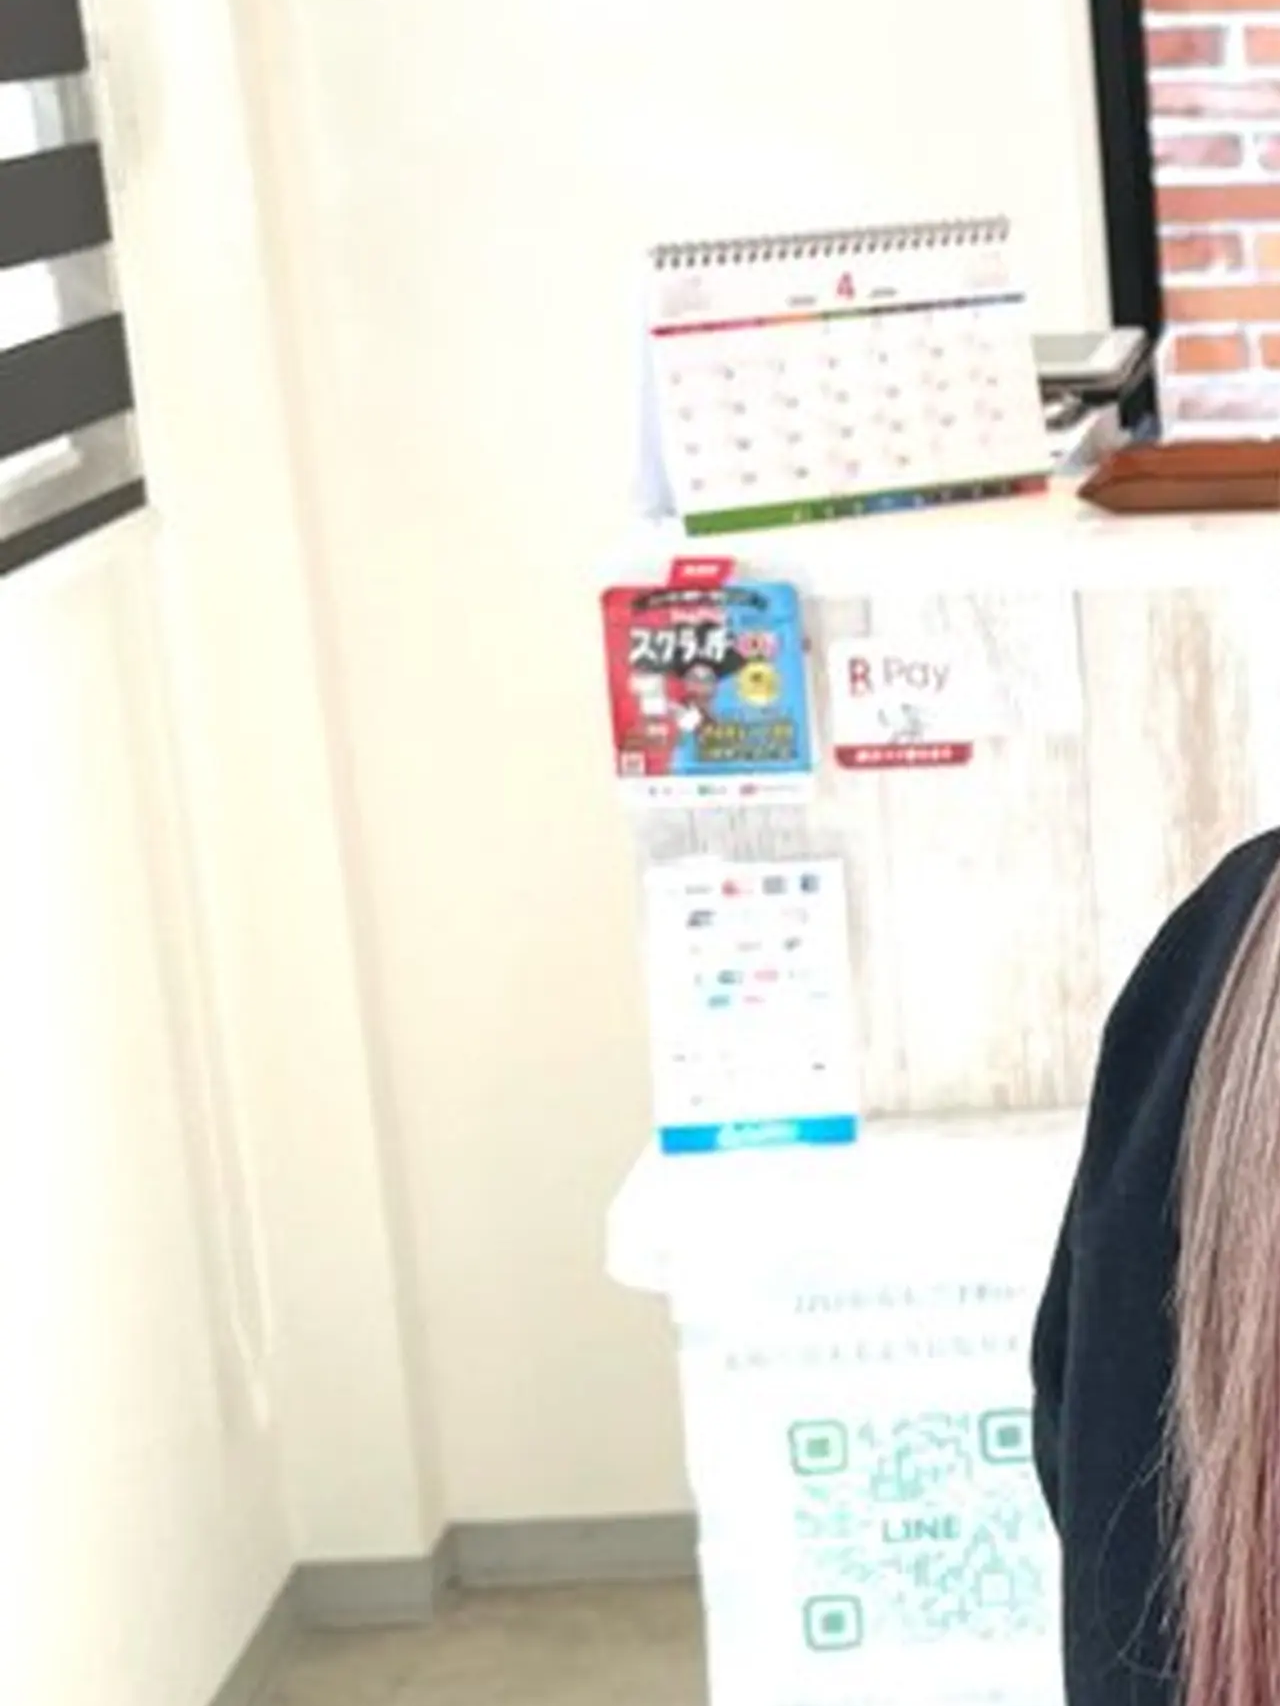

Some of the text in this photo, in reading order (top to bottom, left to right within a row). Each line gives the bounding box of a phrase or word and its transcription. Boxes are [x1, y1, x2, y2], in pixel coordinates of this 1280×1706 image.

[836, 271, 856, 300] 4
[883, 657, 950, 693] Pay
[882, 1515, 961, 1543] LINE
